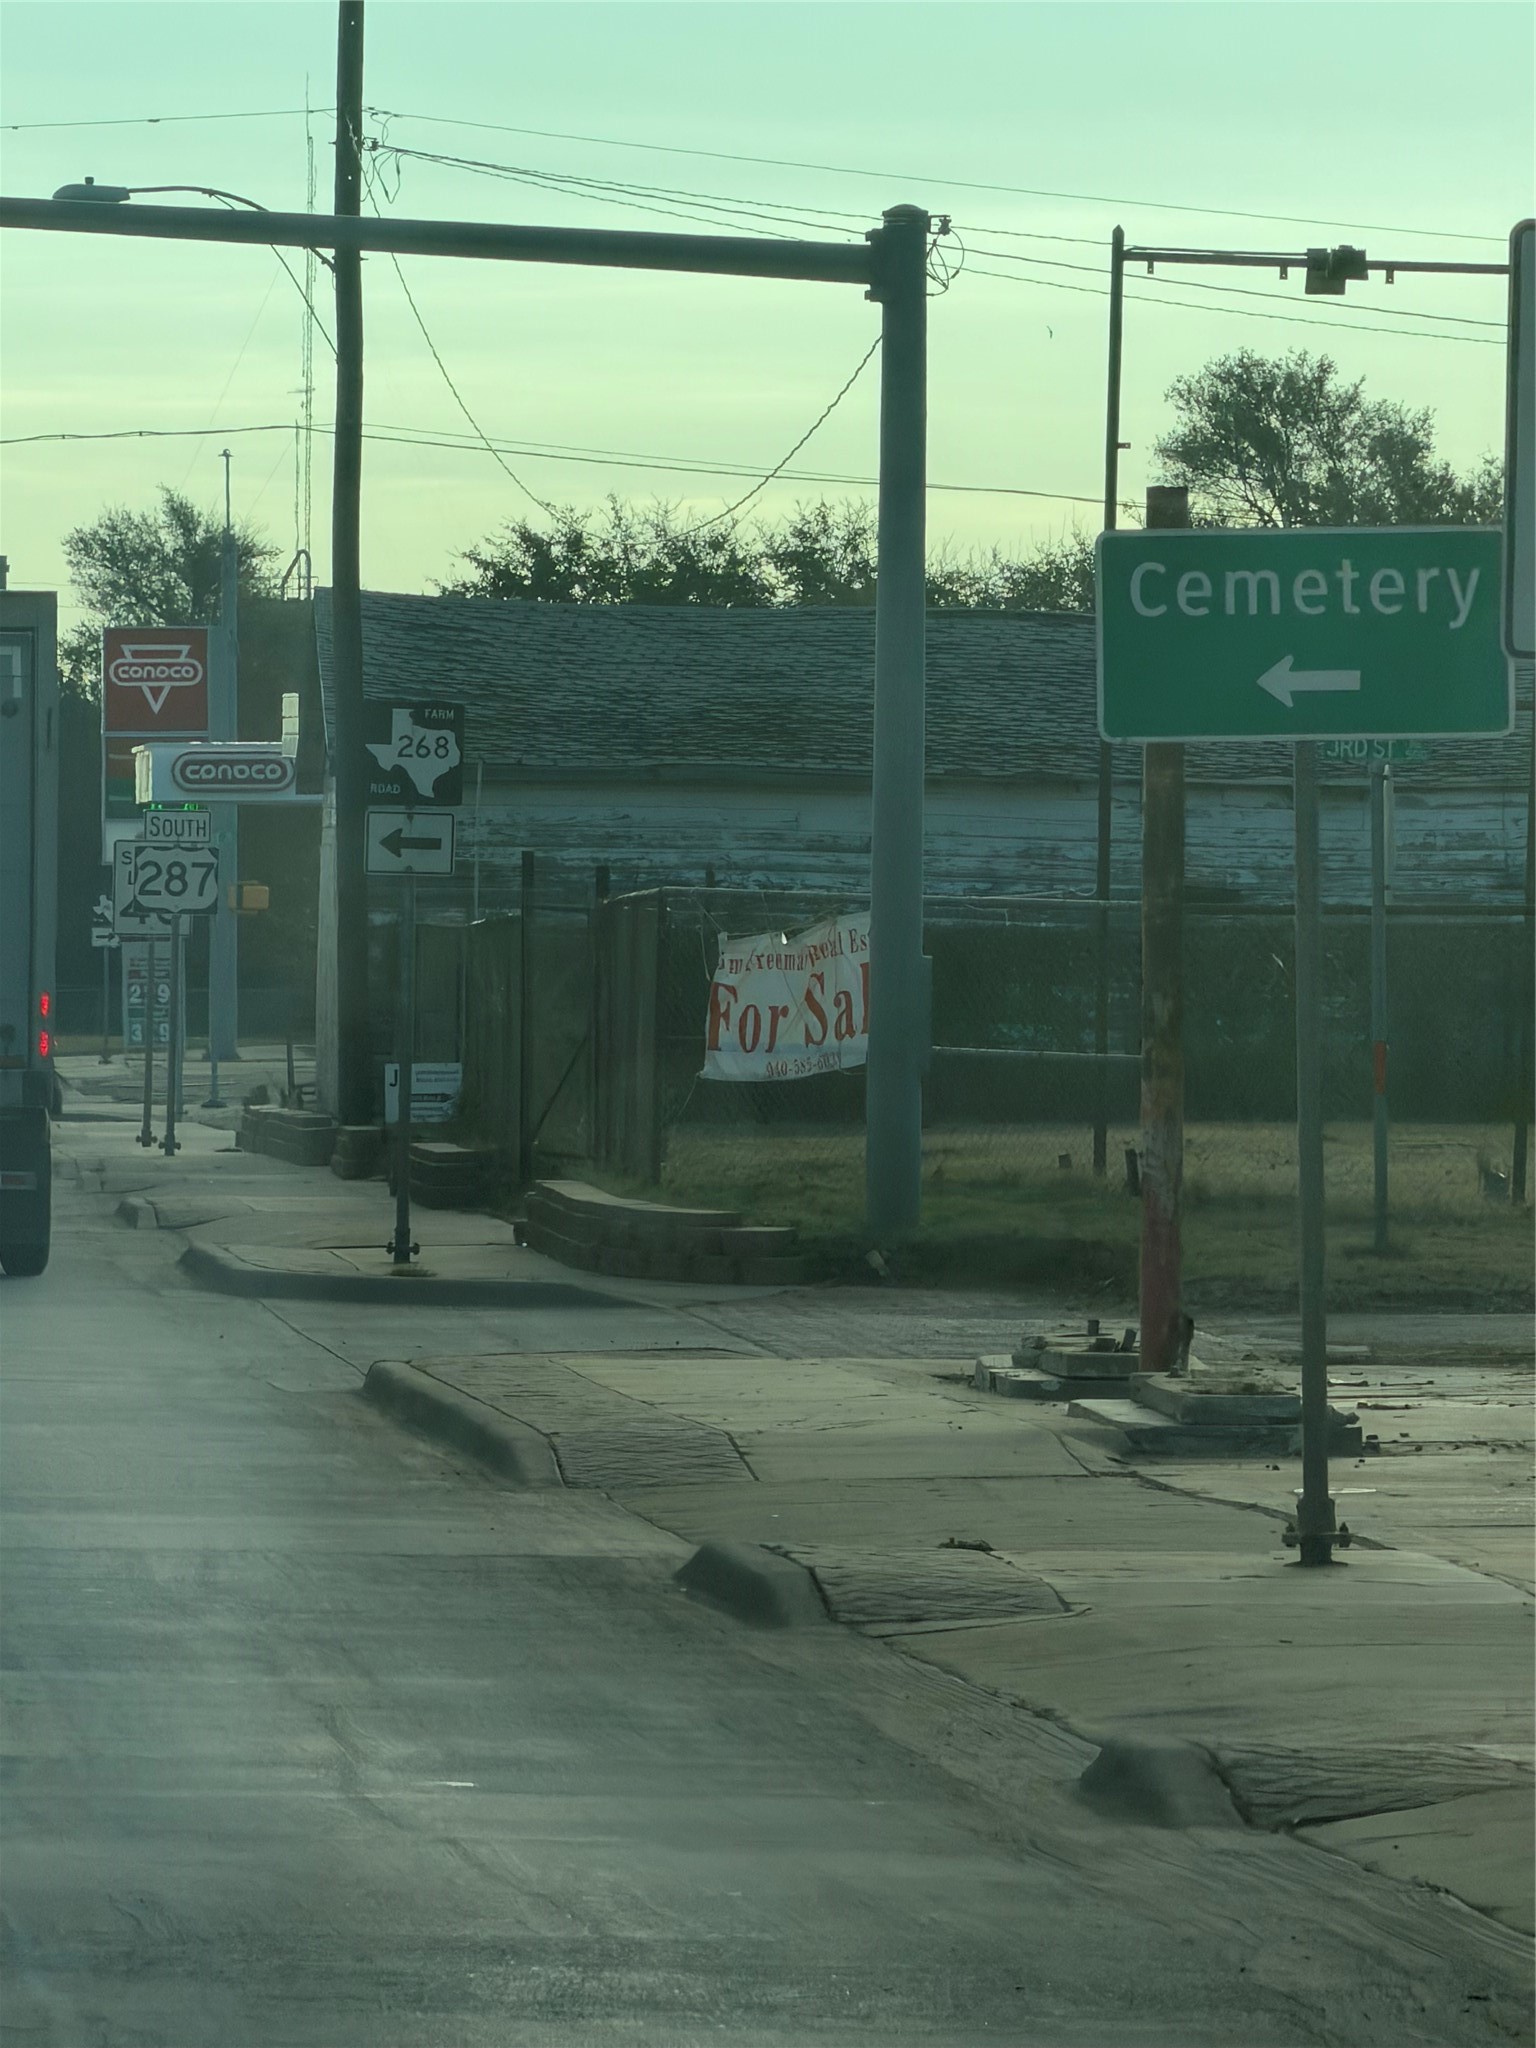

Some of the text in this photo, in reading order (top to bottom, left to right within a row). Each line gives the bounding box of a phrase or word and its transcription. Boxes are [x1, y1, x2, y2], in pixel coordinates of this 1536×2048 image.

[1130, 558, 1480, 629] Cemetery
[424, 709, 455, 721] FARM
[397, 734, 450, 760] 268
[1372, 739, 1397, 758] ST
[370, 783, 401, 795] ROAD
[149, 816, 207, 837] SOUTH
[138, 860, 216, 897] 287
[707, 962, 869, 1053] For Sal
